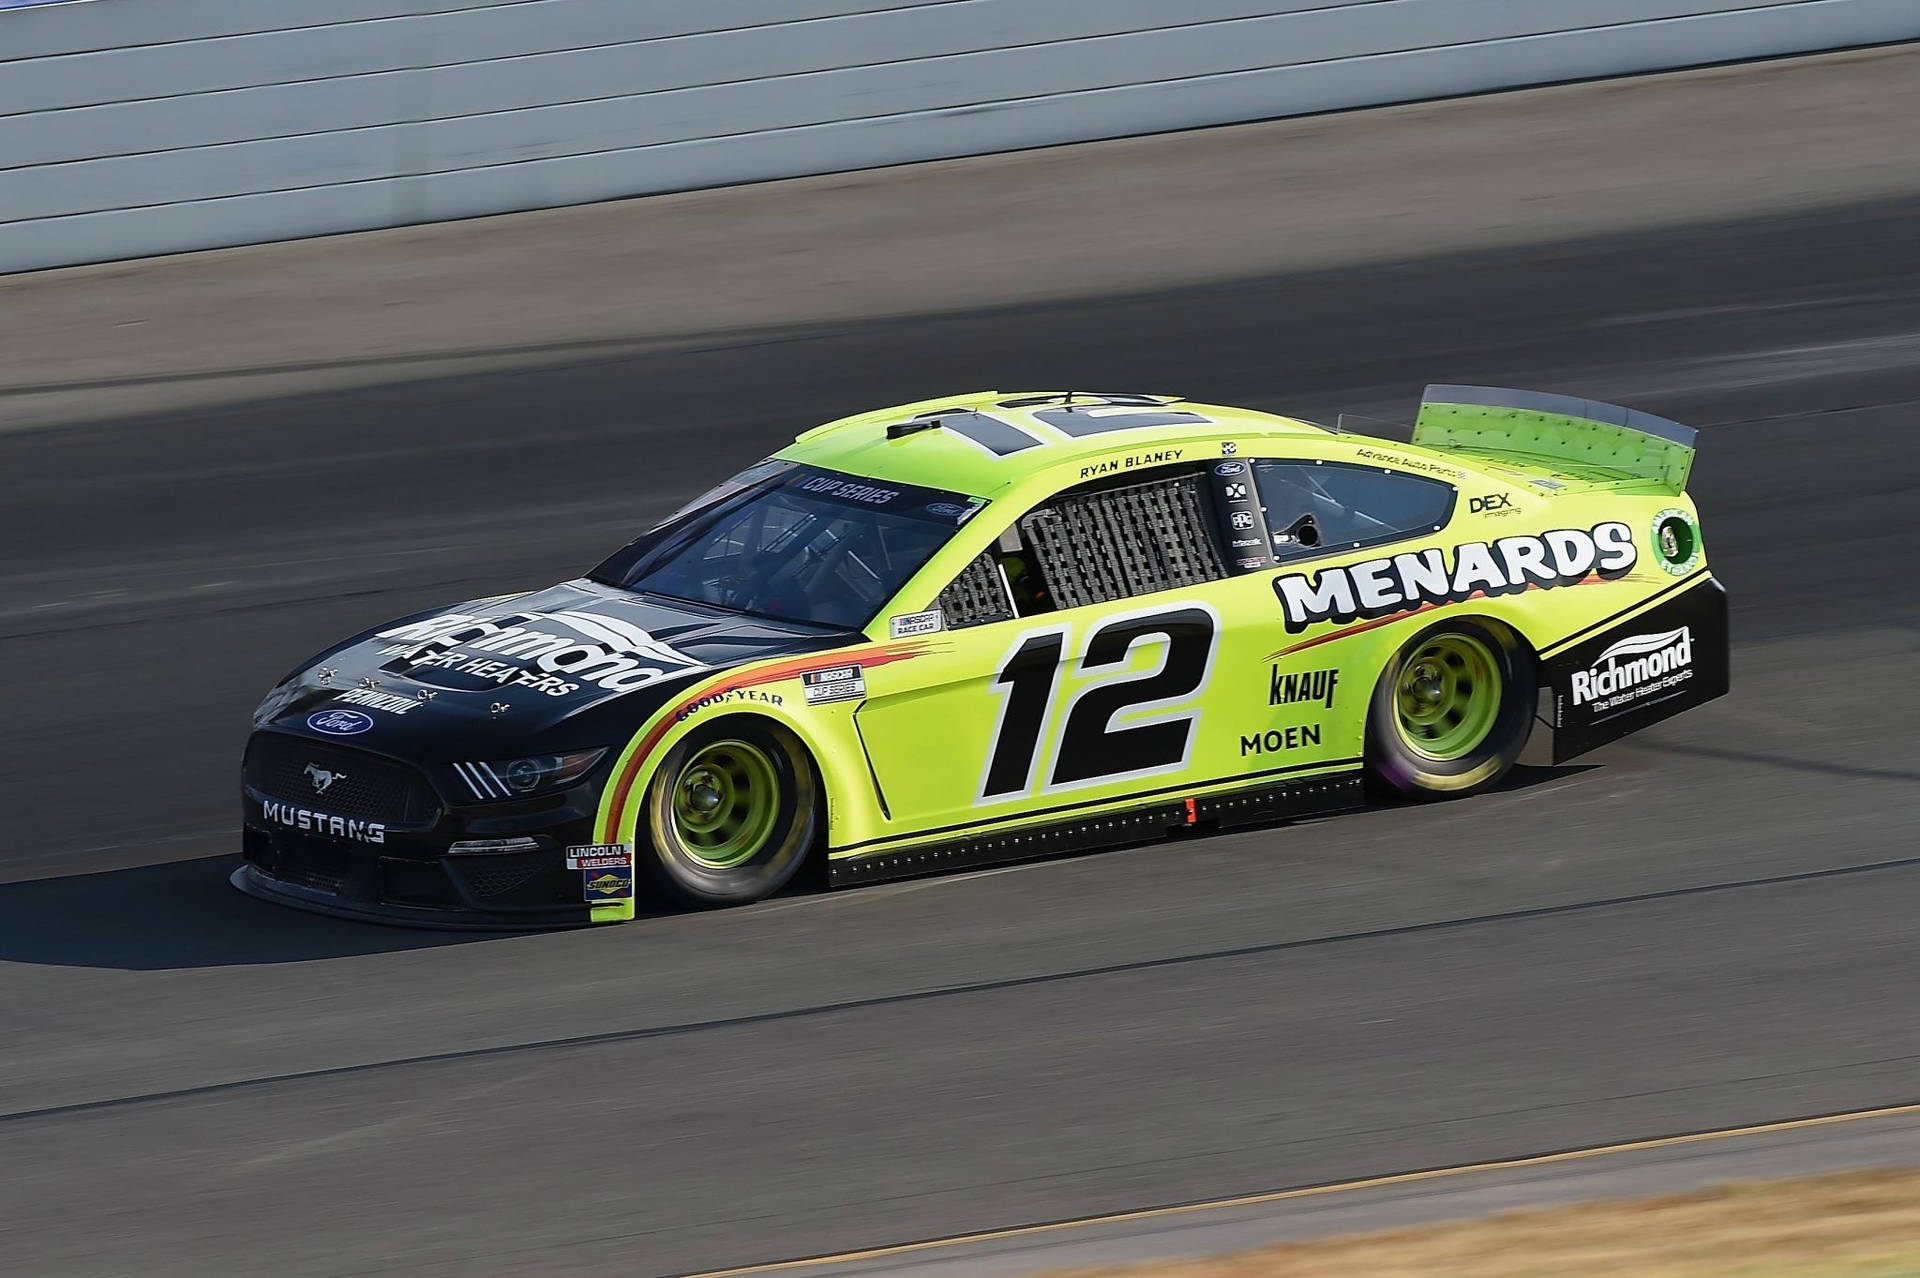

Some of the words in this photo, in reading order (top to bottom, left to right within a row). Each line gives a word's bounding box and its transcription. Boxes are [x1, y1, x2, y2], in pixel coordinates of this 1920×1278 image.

[1079, 460, 1119, 479] RYAN
[1125, 449, 1183, 468] BLANEY
[802, 475, 844, 496] CUP
[834, 481, 900, 505] SERIES
[1469, 492, 1513, 514] DEX
[1275, 522, 1636, 628] MENARDS
[897, 625, 918, 635] RACE
[918, 623, 934, 632] CAR
[376, 643, 468, 669] WATER
[459, 656, 580, 697] HEATERS
[1571, 626, 1692, 706] Richmond
[813, 686, 829, 697] CUP
[829, 682, 856, 694] SERIES
[1269, 663, 1340, 709] KNAUF
[675, 685, 783, 722] GOODYEAR
[979, 606, 1217, 801] 12
[1591, 702, 1610, 713] The
[1240, 723, 1322, 757] MOEN
[263, 800, 386, 844] MUSTANG
[569, 845, 621, 858] LINCOLN
[581, 857, 628, 867] WELDERS
[586, 878, 631, 890] SUNOCO
